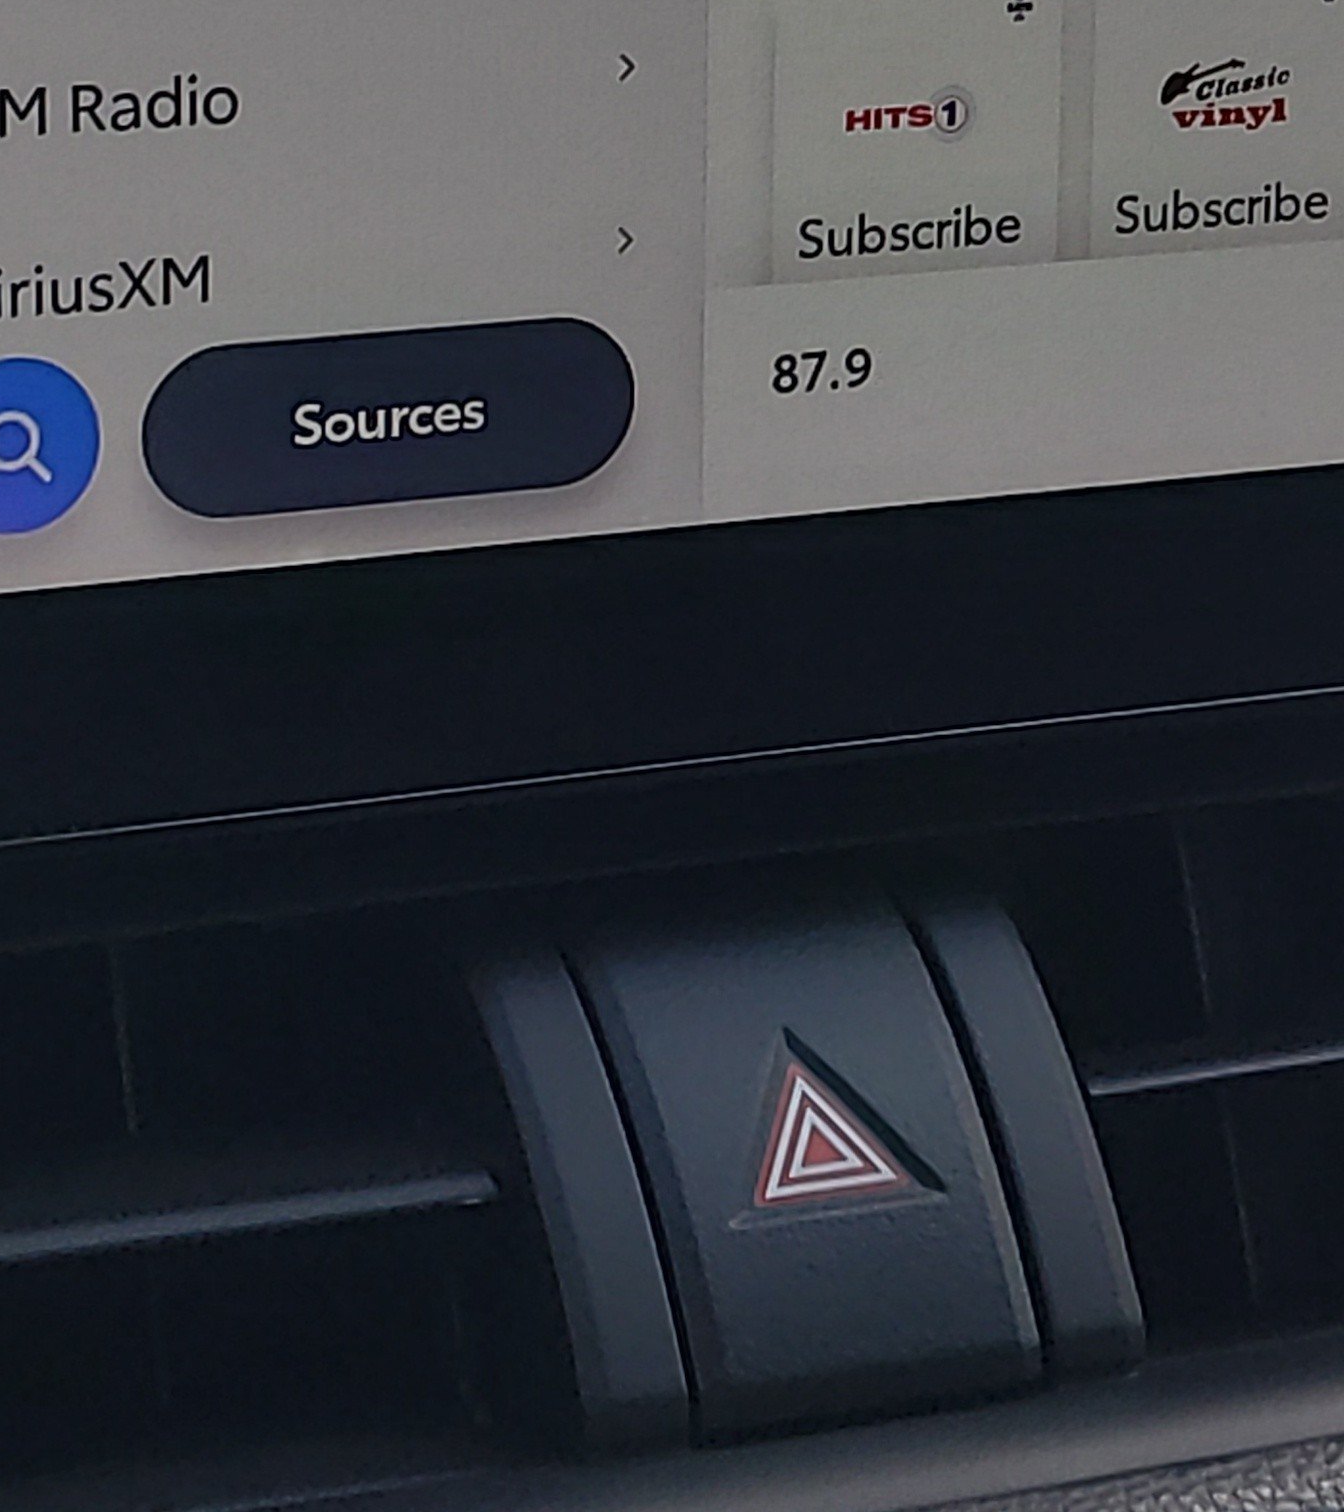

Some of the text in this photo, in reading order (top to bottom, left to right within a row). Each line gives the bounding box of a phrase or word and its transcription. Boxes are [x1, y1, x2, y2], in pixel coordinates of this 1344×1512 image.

[70, 72, 240, 135] Radio
[1195, 65, 1291, 101] Classic
[1172, 97, 1287, 131] vinyl
[797, 203, 1022, 260] Subscribe
[1114, 180, 1330, 235] Subscribe
[770, 345, 874, 396] 87.9
[291, 397, 487, 447] Sources
